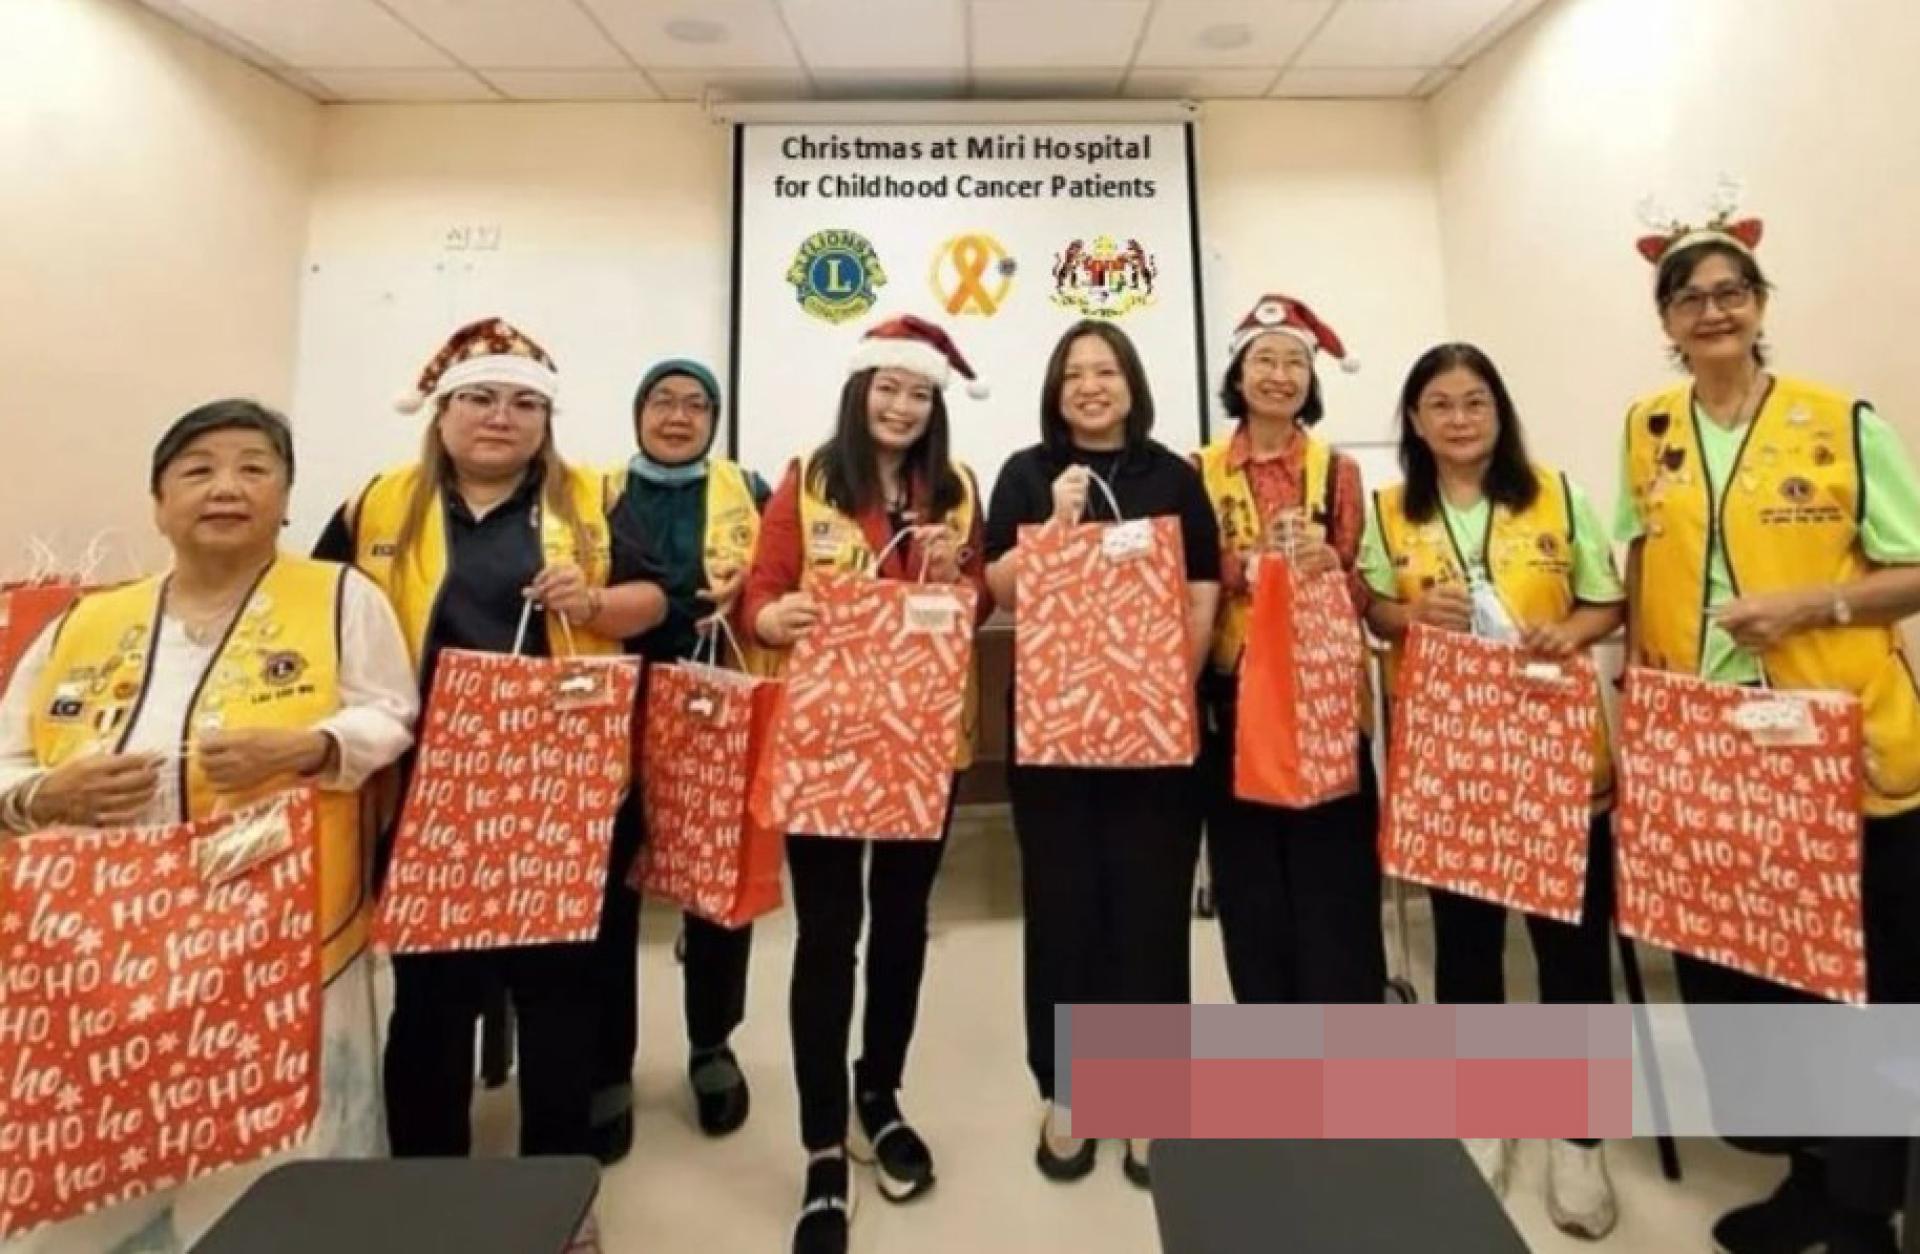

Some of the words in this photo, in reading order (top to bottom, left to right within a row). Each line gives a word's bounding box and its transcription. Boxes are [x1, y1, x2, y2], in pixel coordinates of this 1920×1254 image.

[781, 135, 923, 161] Christmas
[930, 136, 958, 160] at
[967, 136, 1026, 160] Miri
[1034, 135, 1150, 164] Hospital
[774, 175, 809, 197] for
[817, 175, 948, 198] Childhood
[955, 175, 1043, 198] Cancer
[1051, 177, 1156, 198] Patients
[827, 259, 852, 293] L
[14, 856, 75, 889] HO
[94, 858, 141, 894] ho
[29, 895, 81, 944] ho
[113, 888, 171, 929] HO
[206, 882, 249, 911] ho
[45, 960, 99, 999] HO
[113, 942, 156, 986] ho
[166, 930, 215, 970] ho
[219, 919, 267, 958] HO
[0, 1008, 48, 1041] HO
[69, 1004, 117, 1046] ho
[165, 968, 224, 1009] HO
[244, 961, 287, 999] ho
[13, 1050, 61, 1099] ho
[89, 1036, 149, 1084] HO
[188, 1010, 237, 1060] ho
[29, 1118, 82, 1161] HO
[97, 1097, 141, 1141] ho
[149, 1082, 200, 1121] ho
[208, 1064, 262, 1107] HO
[55, 1163, 104, 1201] ho
[159, 1119, 215, 1158] HO
[236, 1102, 283, 1143] ho
